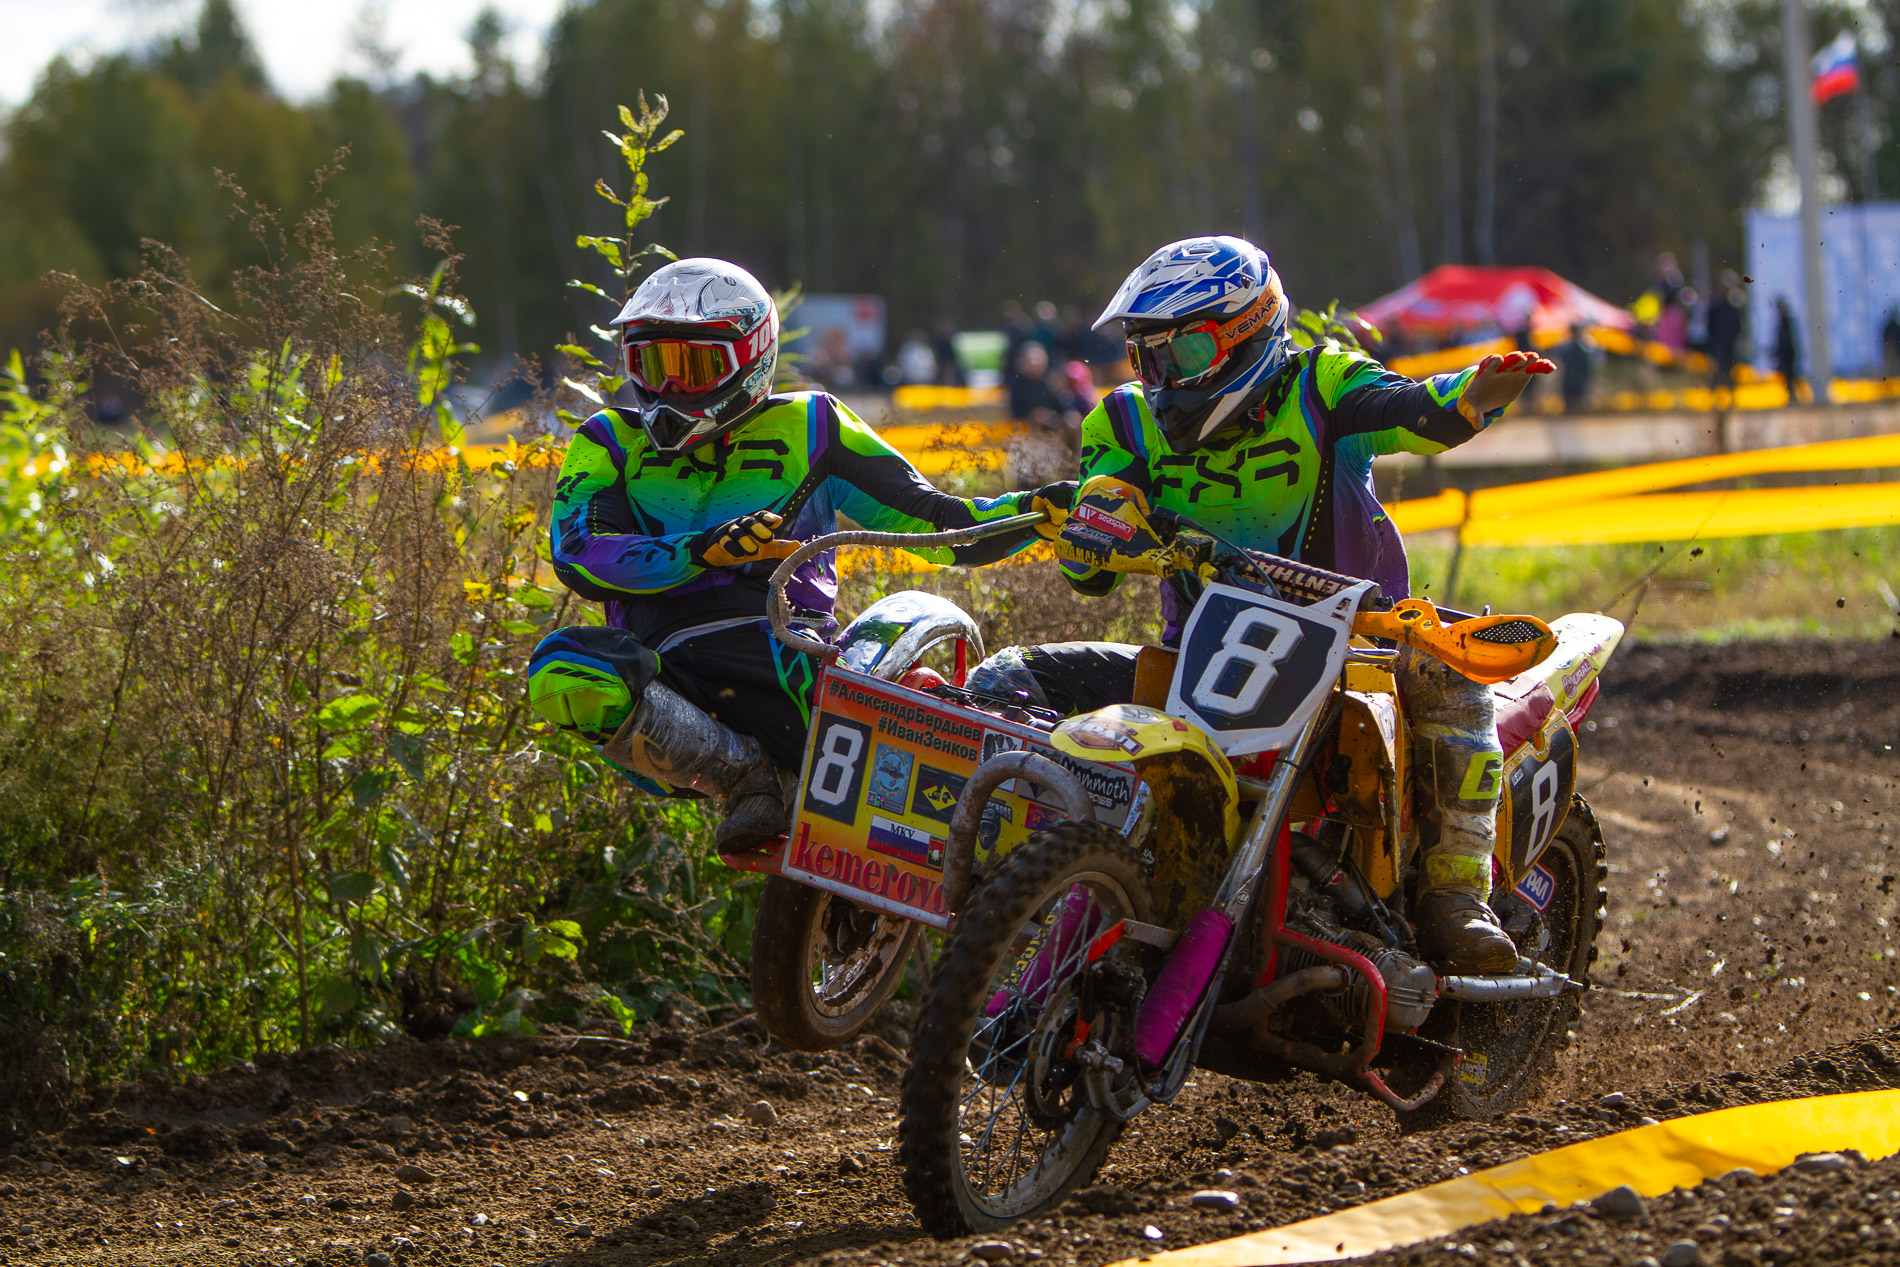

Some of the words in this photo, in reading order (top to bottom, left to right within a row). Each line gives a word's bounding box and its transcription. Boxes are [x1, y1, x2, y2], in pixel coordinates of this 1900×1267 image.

[1225, 296, 1276, 340] VEMAR
[1097, 513, 1132, 533] seaspan
[1246, 559, 1348, 594] ENTHAL
[1192, 607, 1303, 719] 8
[1572, 662, 1592, 685] URAL
[829, 679, 982, 742] #АлександрБердыев
[809, 723, 863, 806] 8
[878, 715, 978, 762] #ИванЗенков
[1524, 759, 1558, 867] 8
[792, 821, 950, 914] kemerovo
